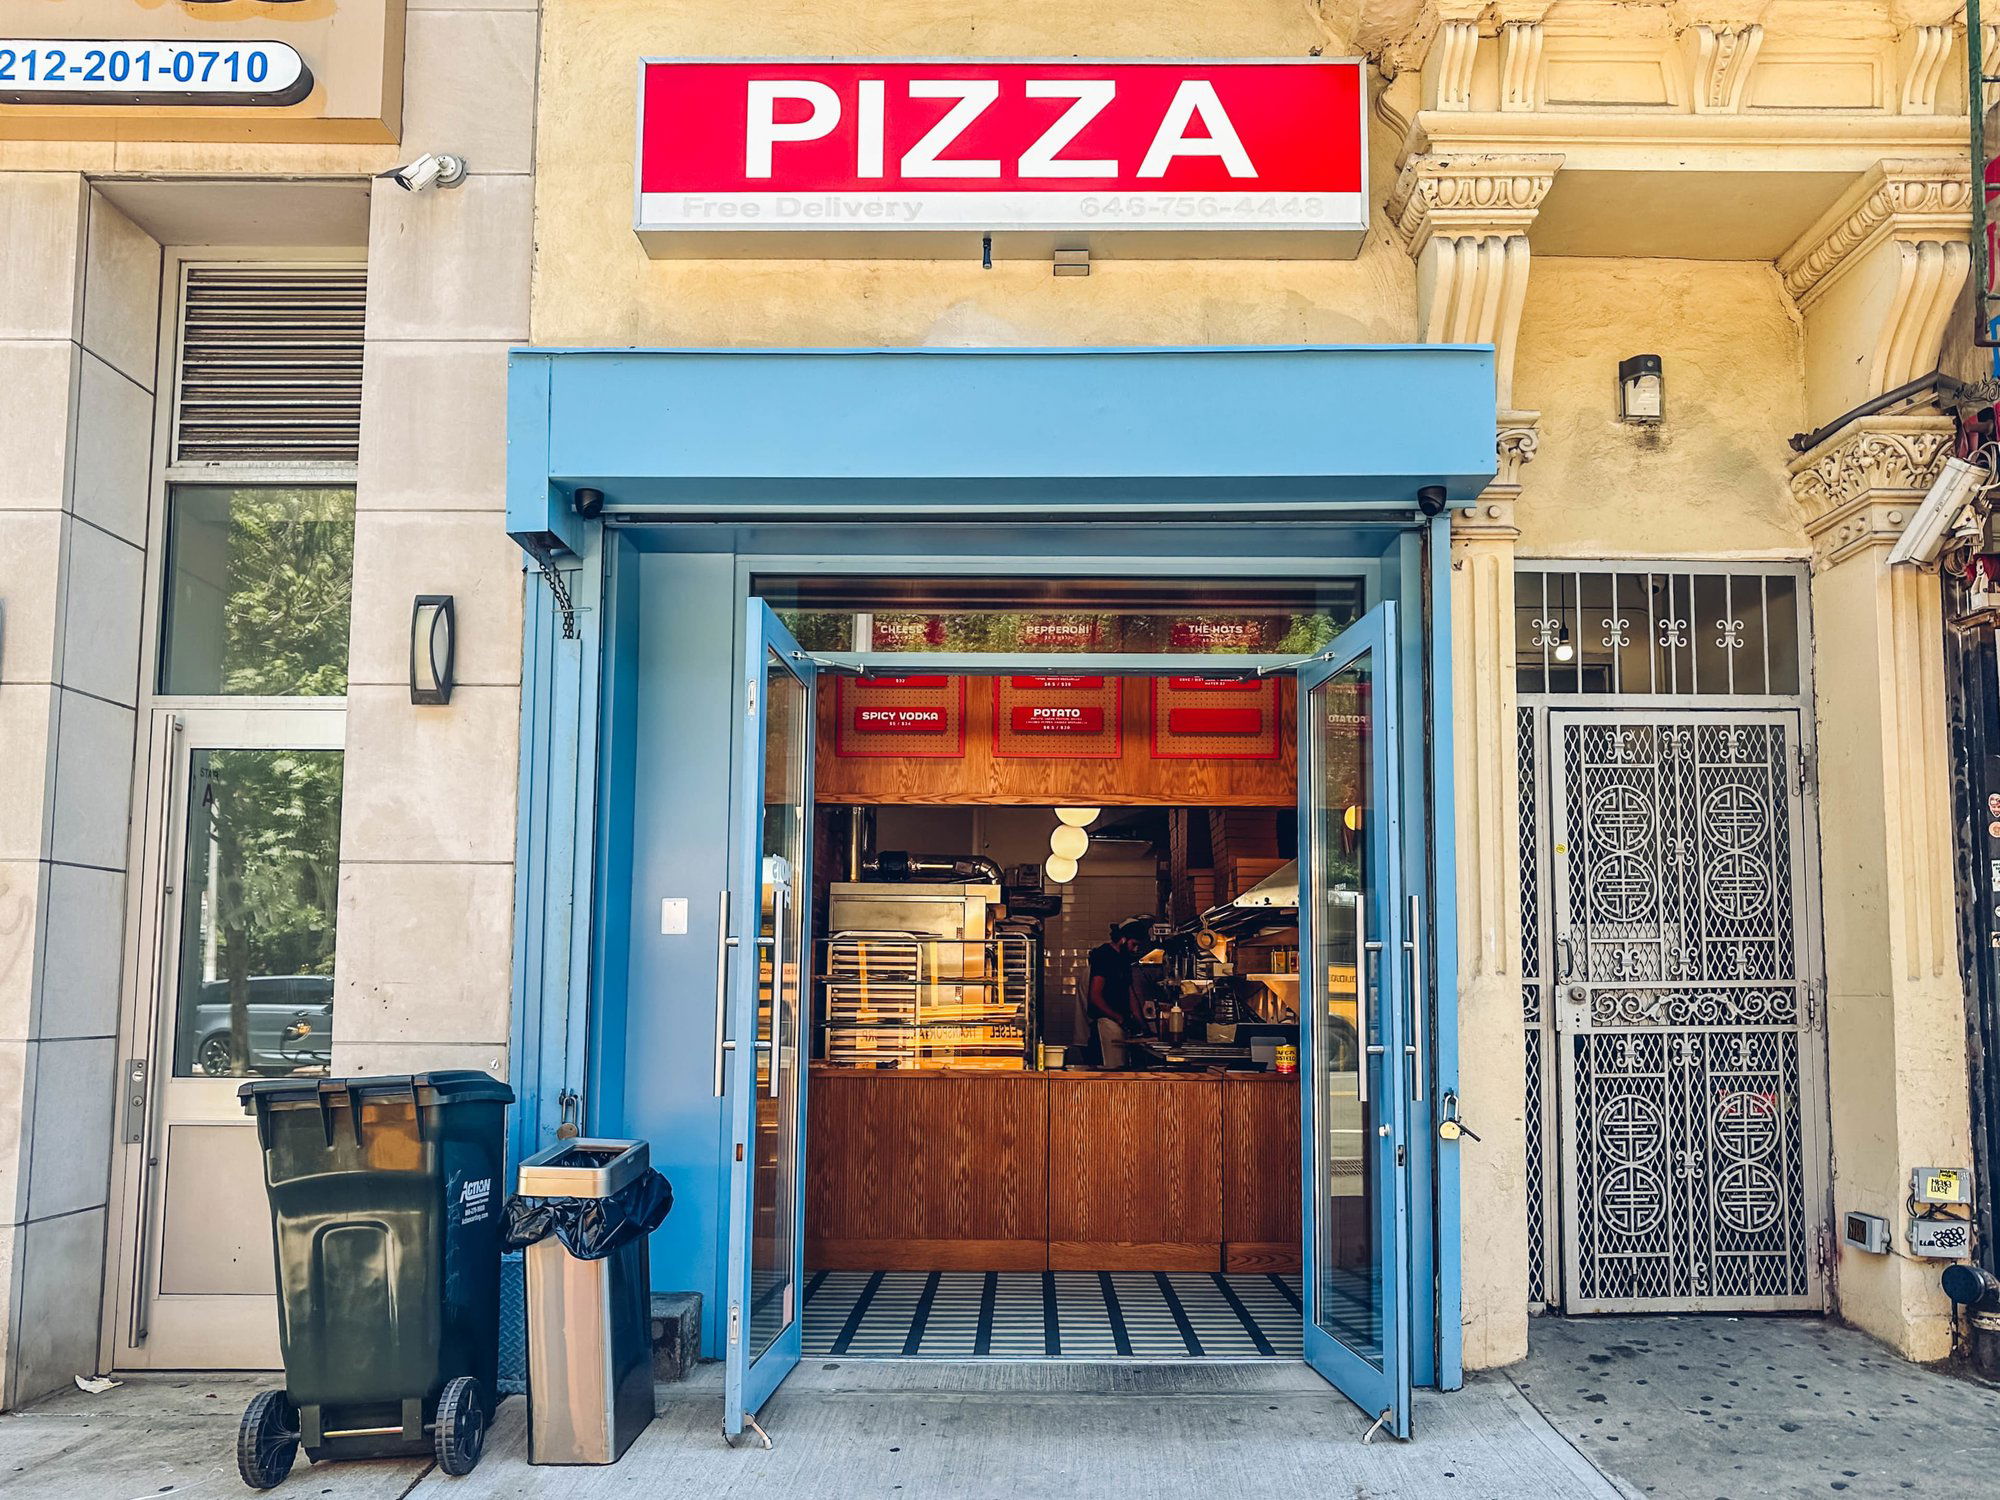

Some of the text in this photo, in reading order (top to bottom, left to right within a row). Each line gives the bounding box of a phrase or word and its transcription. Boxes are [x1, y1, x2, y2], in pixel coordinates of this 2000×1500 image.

[0, 49, 269, 83] 212-201-0710
[745, 79, 1259, 180] PIZZA
[683, 195, 924, 222] Free Delivery
[880, 624, 925, 634] CHEESE
[1026, 624, 1090, 635] PEPPERONI
[1188, 624, 1244, 634] THE HOTS
[861, 711, 939, 721] SPICY VODKA
[1033, 708, 1081, 718] POTATO
[202, 783, 219, 808] A
